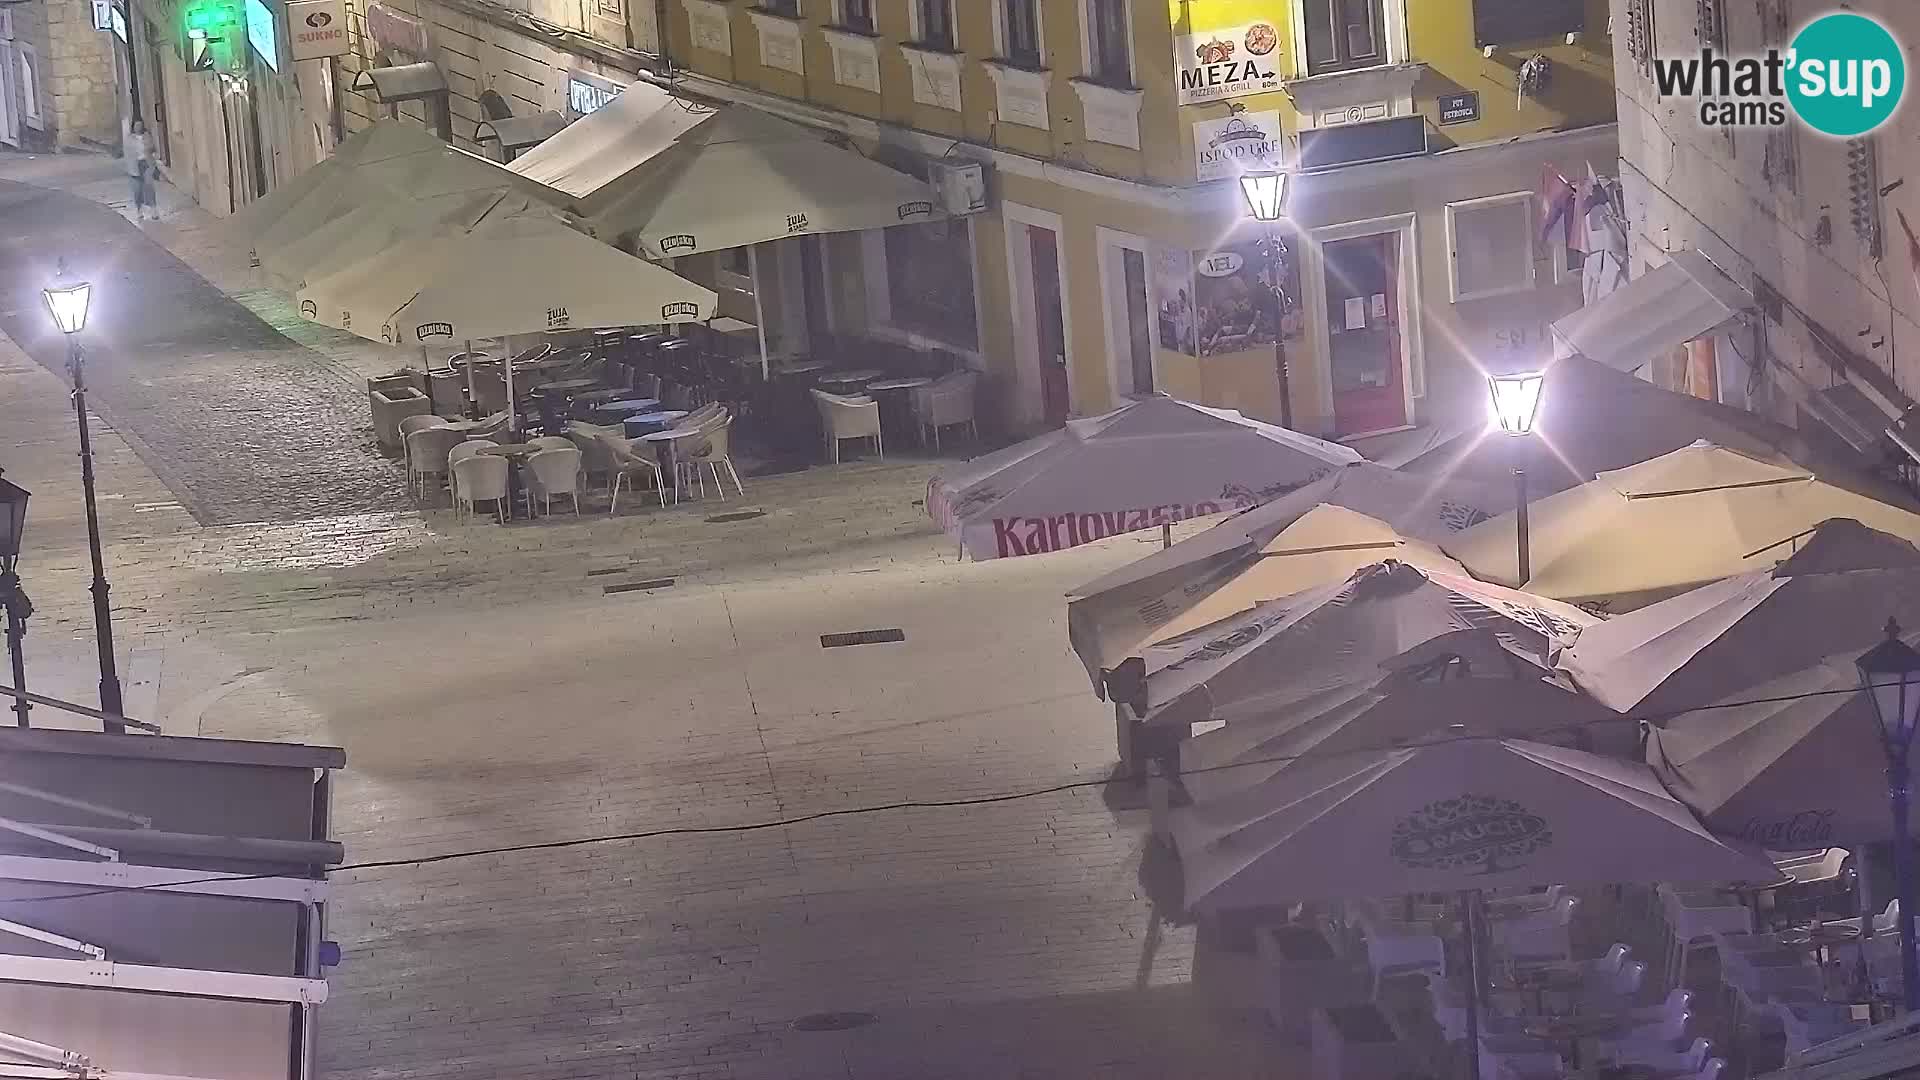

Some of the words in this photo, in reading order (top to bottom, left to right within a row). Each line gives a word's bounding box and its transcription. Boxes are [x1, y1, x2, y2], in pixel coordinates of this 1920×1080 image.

[297, 30, 342, 43] SUKNO
[1181, 60, 1260, 90] MEZA
[1190, 86, 1224, 97] PIZZERIA
[1230, 82, 1252, 92] GRILL
[1200, 145, 1245, 163] ISPOD
